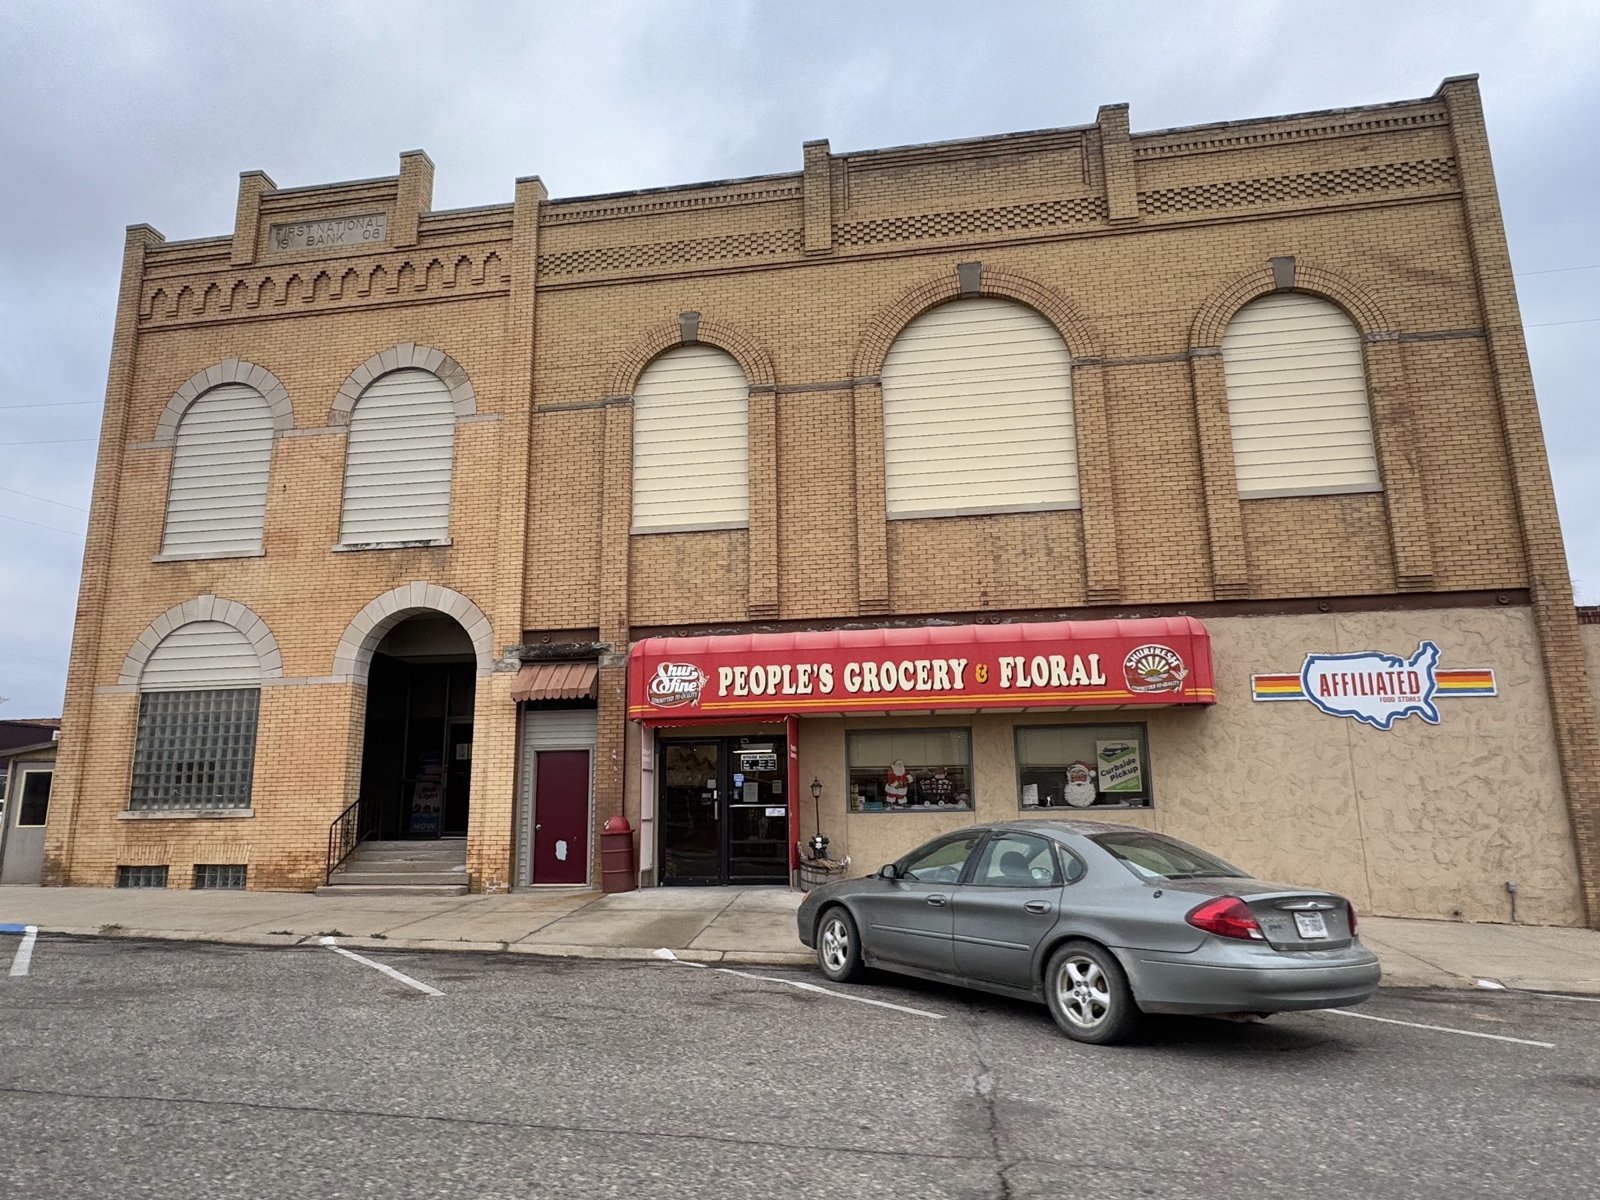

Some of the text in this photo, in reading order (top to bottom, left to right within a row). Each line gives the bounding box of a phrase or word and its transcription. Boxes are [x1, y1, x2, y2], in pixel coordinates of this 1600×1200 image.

[276, 218, 383, 240] FIRST NATIONAL
[277, 229, 380, 249] 19 BANK 08
[1126, 647, 1180, 669] SHURFRESH
[718, 653, 1107, 696] PEOPLE'S GROCERY & FLORAL
[1319, 670, 1421, 697] AFFILIATED
[1100, 758, 1136, 777] Curbside
[1110, 765, 1138, 782] Pickup
